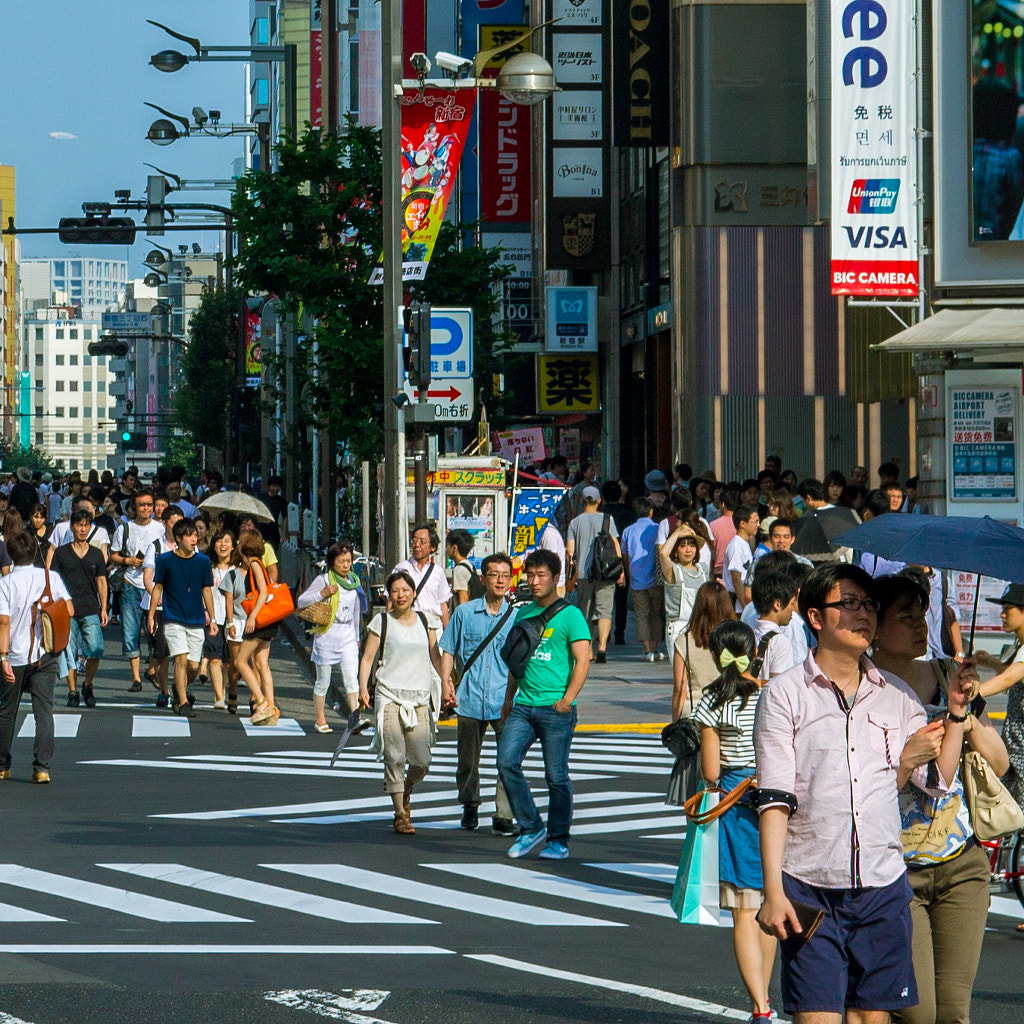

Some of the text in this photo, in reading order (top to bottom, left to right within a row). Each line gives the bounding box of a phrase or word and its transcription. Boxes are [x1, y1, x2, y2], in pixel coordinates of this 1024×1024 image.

[589, 16, 600, 24] 4F
[589, 73, 600, 81] 3F
[435, 106, 465, 123] 新宿
[589, 130, 600, 139] 3F
[590, 187, 601, 195] B1
[852, 187, 896, 198] UnionPay
[841, 226, 908, 249] VISA
[833, 272, 916, 285] BIC CAMERA
[545, 359, 593, 407] 薬
[953, 401, 985, 410] AIRPORT
[953, 410, 985, 419] DELIVERY
[455, 470, 504, 485] スクラッチ
